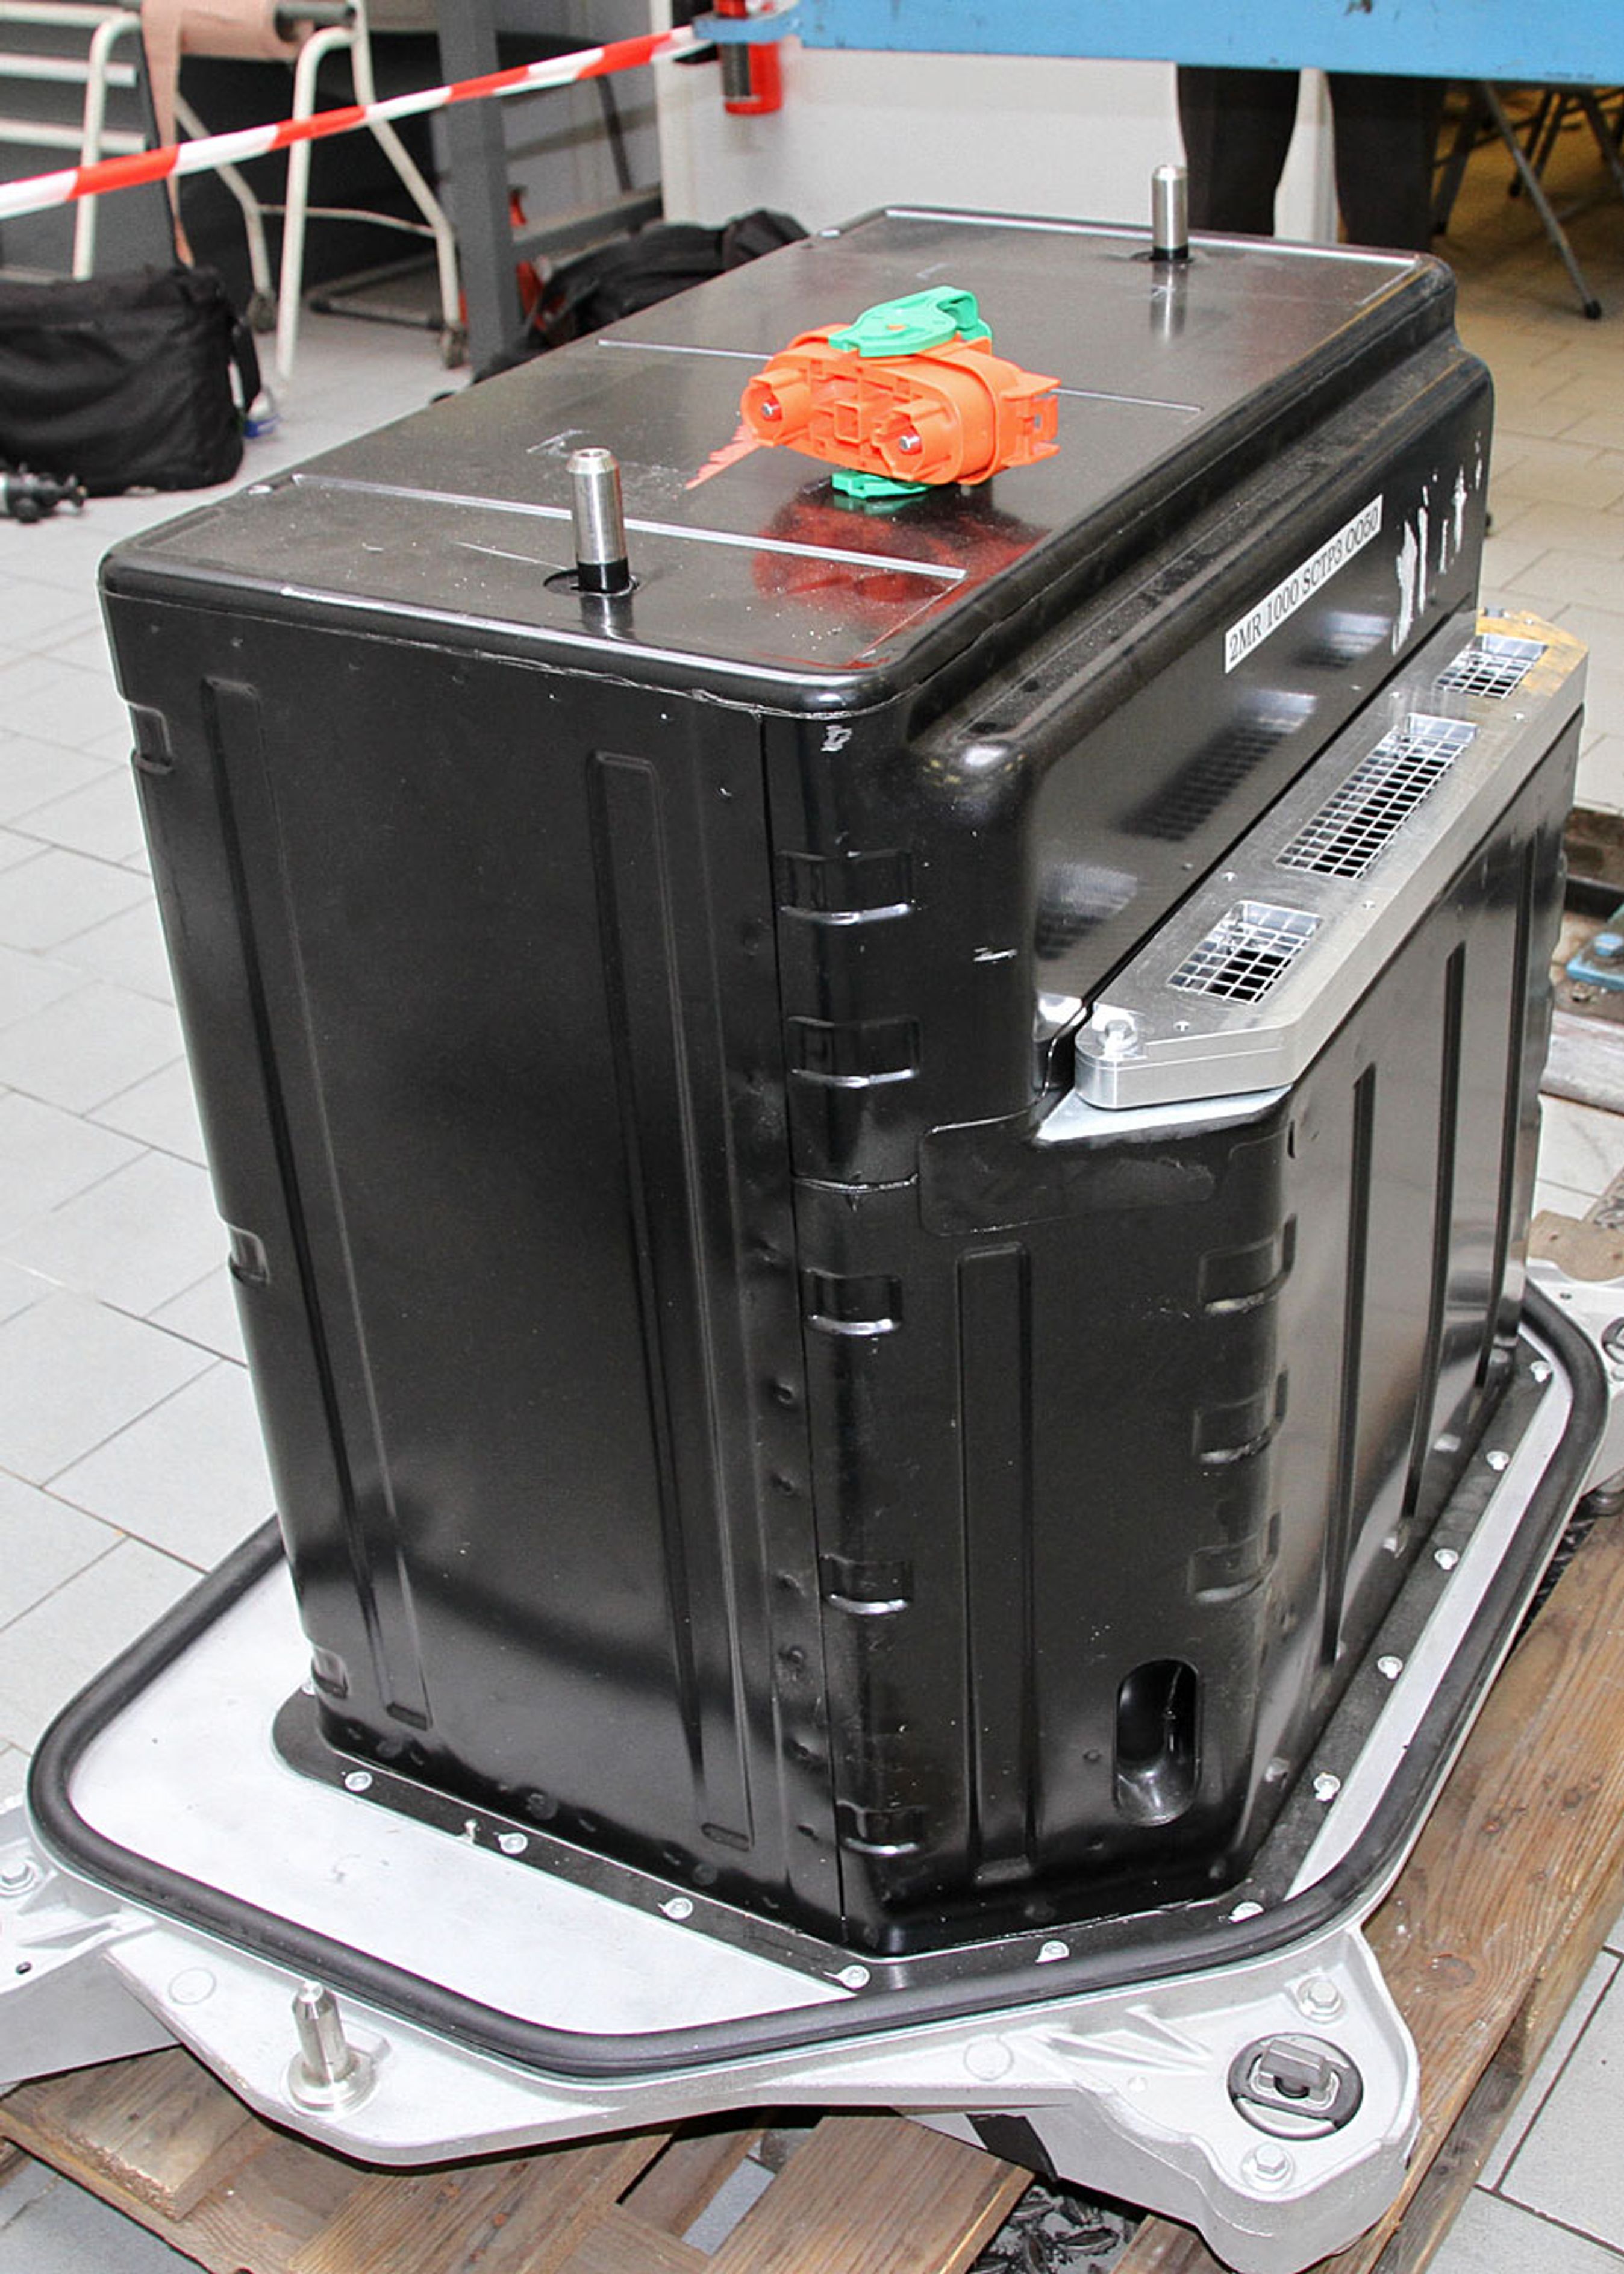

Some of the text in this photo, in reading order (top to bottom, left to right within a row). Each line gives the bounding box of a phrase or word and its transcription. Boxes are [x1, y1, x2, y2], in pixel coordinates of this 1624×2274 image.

[1229, 613, 1261, 662] 2MR
[1267, 579, 1299, 628] 1000
[1301, 539, 1343, 595] SCTP3
